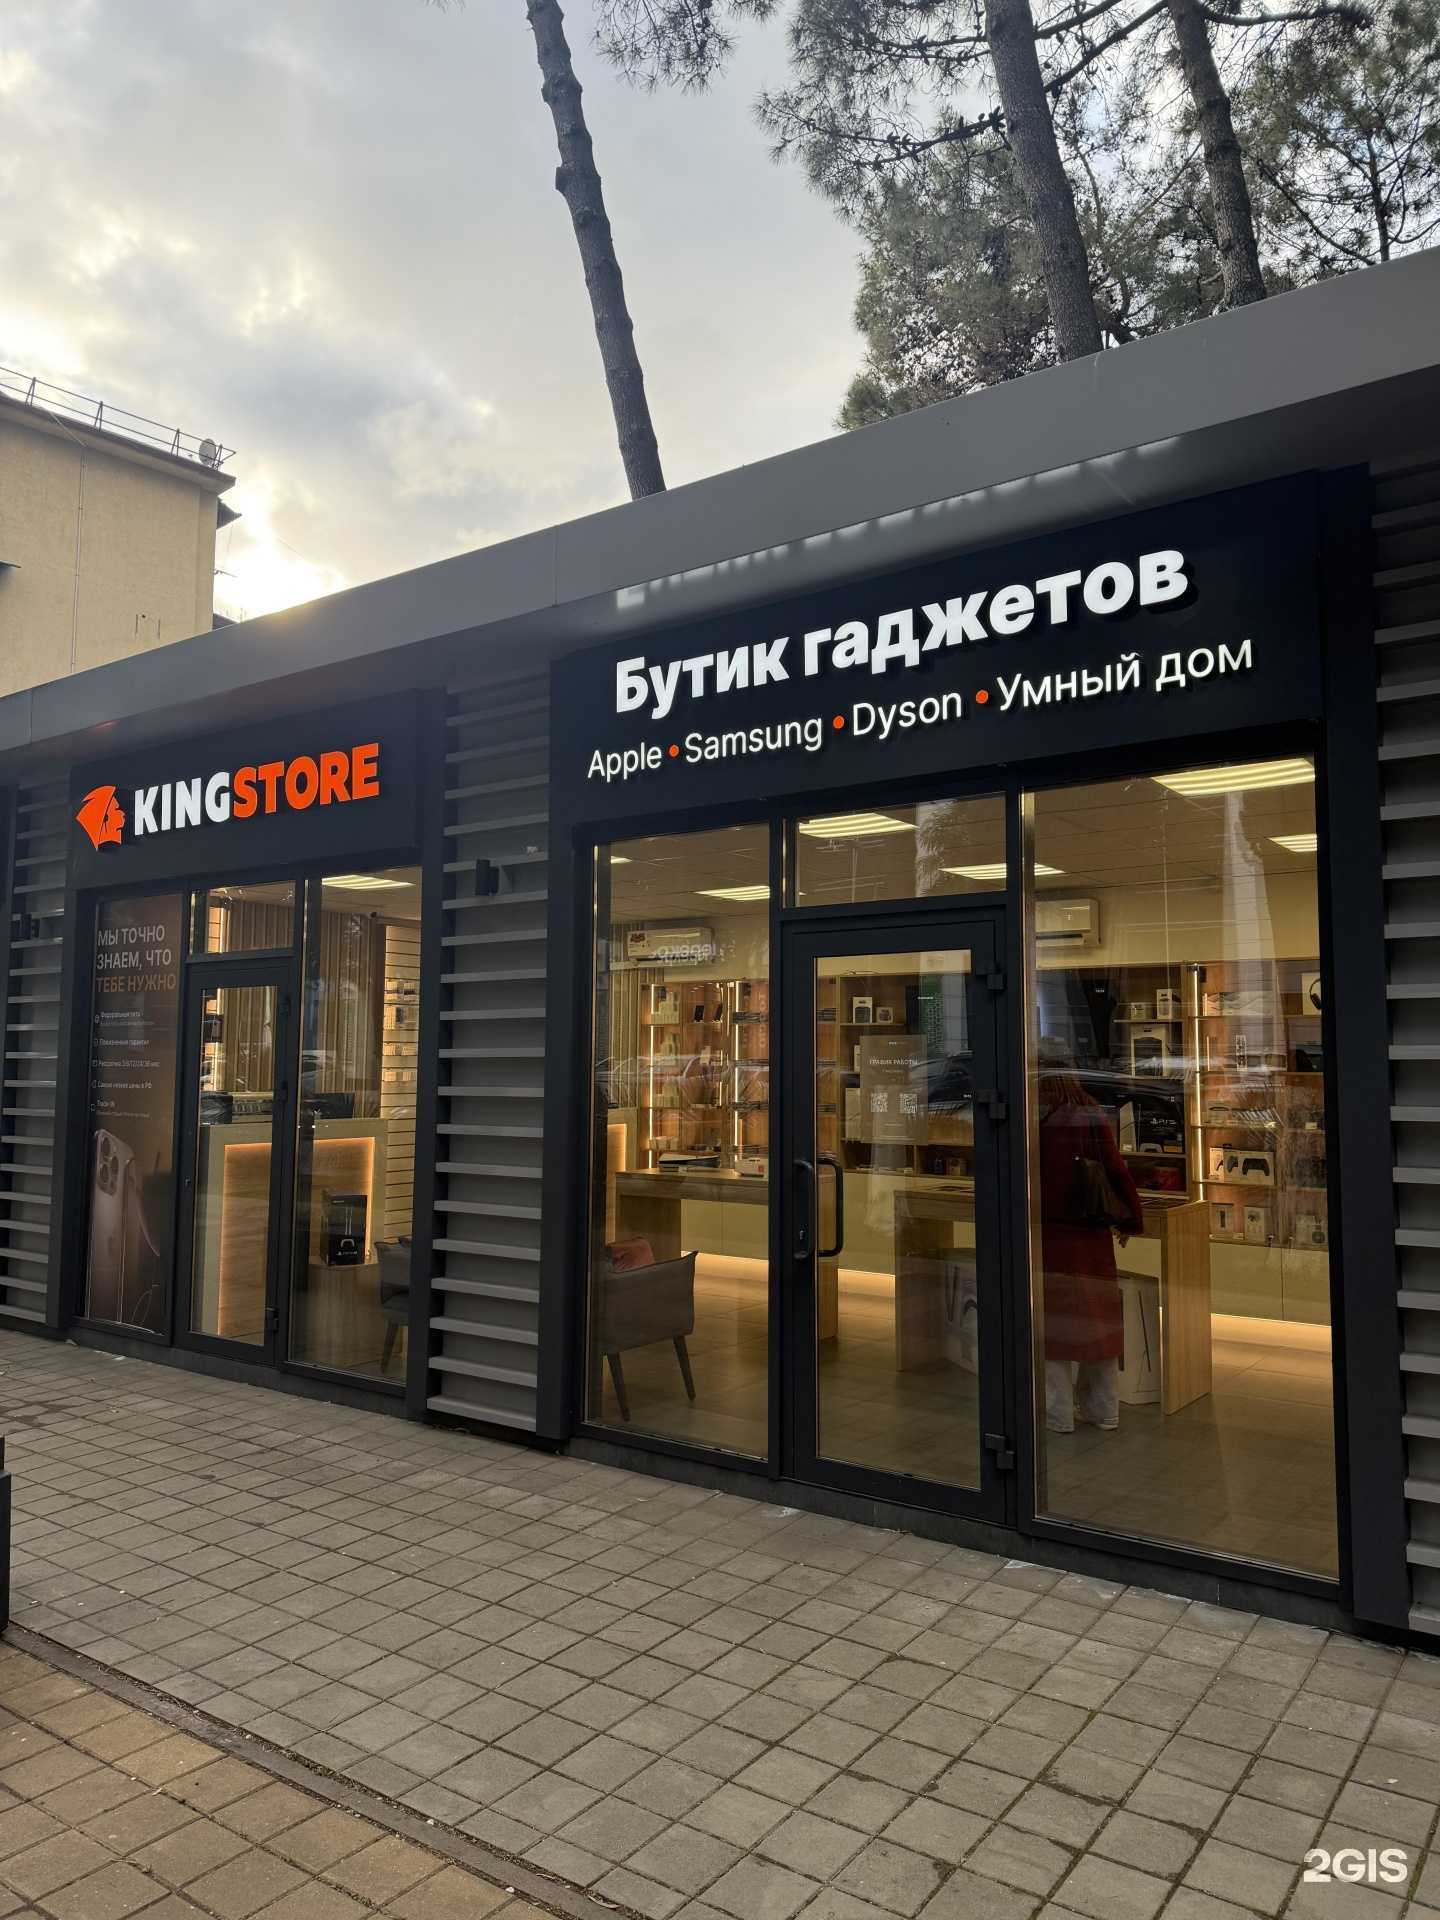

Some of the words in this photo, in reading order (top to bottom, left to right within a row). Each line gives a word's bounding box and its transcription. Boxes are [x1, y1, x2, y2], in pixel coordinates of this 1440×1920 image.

[616, 636, 791, 720] Бутик
[804, 550, 1189, 677] гаджетов
[588, 742, 663, 782] Apple
[684, 716, 823, 763] Samsung
[853, 692, 963, 740] Dyson
[996, 652, 1141, 711] Умный
[1155, 639, 1254, 692] дом
[134, 742, 380, 836] KINGSTORE
[96, 951, 143, 970] ЗНАЕМ,
[146, 948, 172, 967] ЧТО
[97, 929, 120, 947] МЫ
[120, 924, 166, 945] ТОЧНО
[96, 976, 126, 993] ТЕБЕ
[127, 973, 177, 992] НУЖНО
